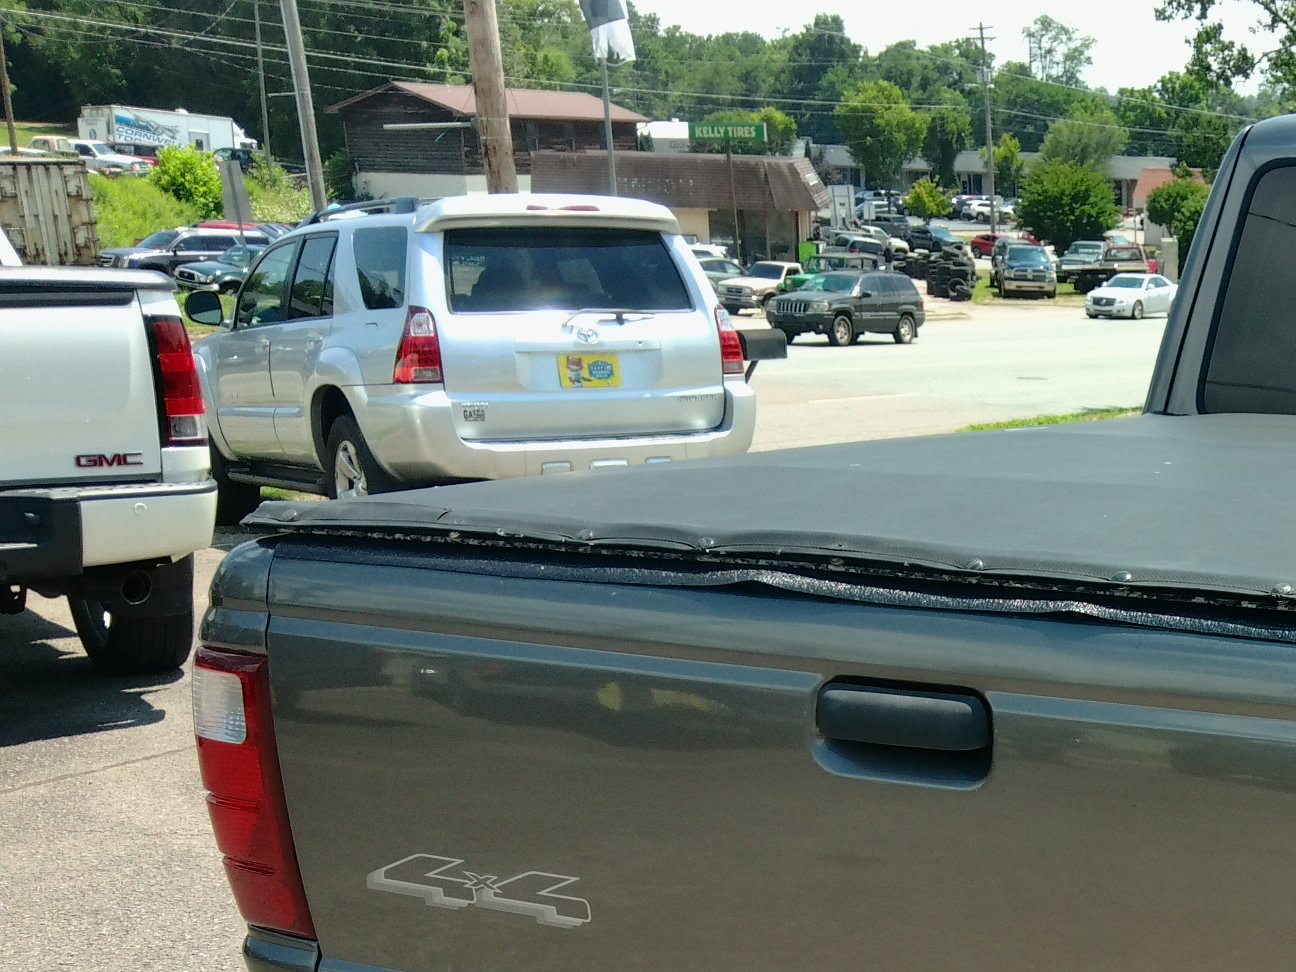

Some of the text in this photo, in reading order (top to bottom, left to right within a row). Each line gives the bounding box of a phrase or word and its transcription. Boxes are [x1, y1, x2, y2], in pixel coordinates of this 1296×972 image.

[695, 126, 756, 138] KELLY TIRES
[76, 452, 143, 467] GMC
